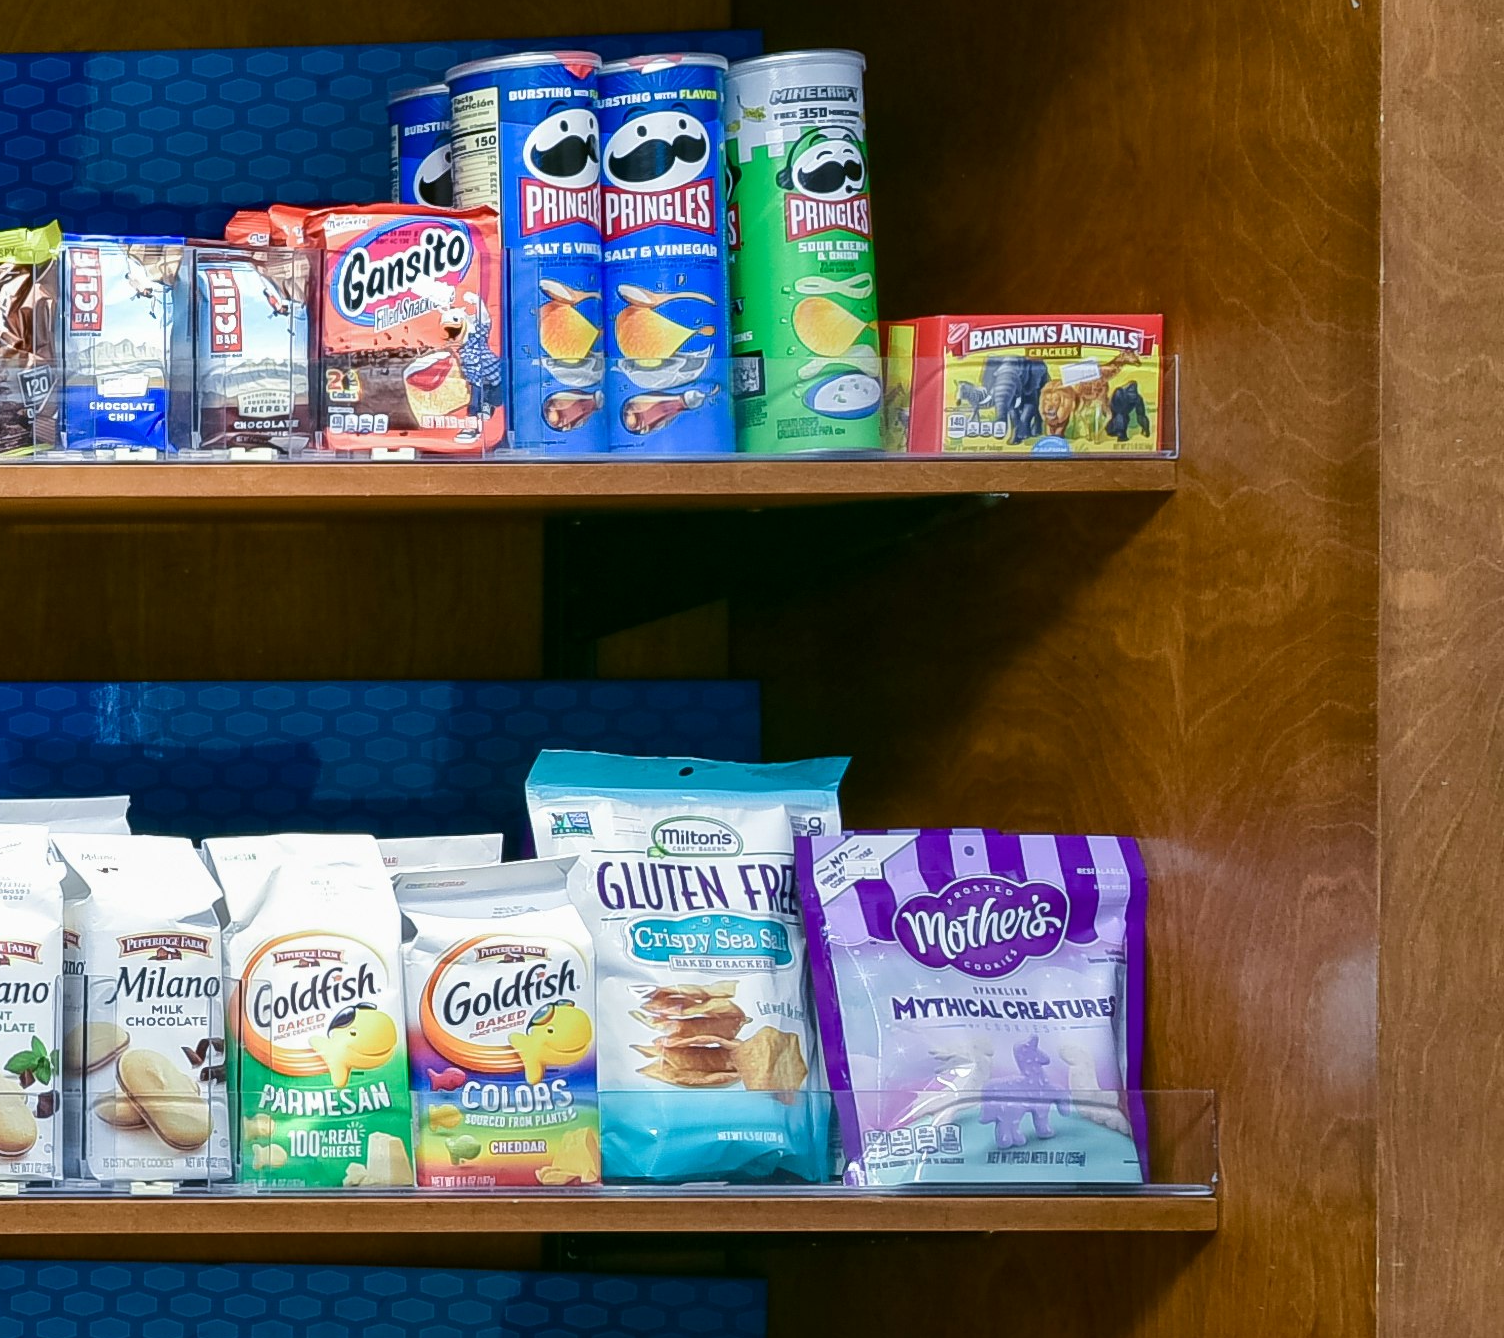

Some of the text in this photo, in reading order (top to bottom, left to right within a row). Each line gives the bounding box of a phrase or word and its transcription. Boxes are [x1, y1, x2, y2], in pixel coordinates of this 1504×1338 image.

[604, 187, 716, 236] PRINGLES
[790, 198, 869, 233] PRINGLES
[604, 243, 717, 262] SALT VINEGAR
[74, 249, 101, 310] CLIF
[338, 228, 466, 312] Gansito
[75, 312, 99, 324] BAR
[968, 326, 1141, 353] BARNUM'S ANIMALS
[89, 401, 156, 413] CHOCOLATE
[109, 411, 136, 422] CHIP
[660, 828, 734, 848] Milton's
[597, 861, 729, 913] GLUTEN
[635, 925, 751, 956] Crispy Sea
[902, 896, 1054, 952] Mother's
[253, 967, 378, 1030] Goldfish
[893, 996, 1116, 1020] MYTHICAL CREATURES
[259, 1083, 391, 1118] PARMESAN
[460, 1079, 574, 1115] COLORS
[489, 1139, 548, 1155] CHEDDAR
